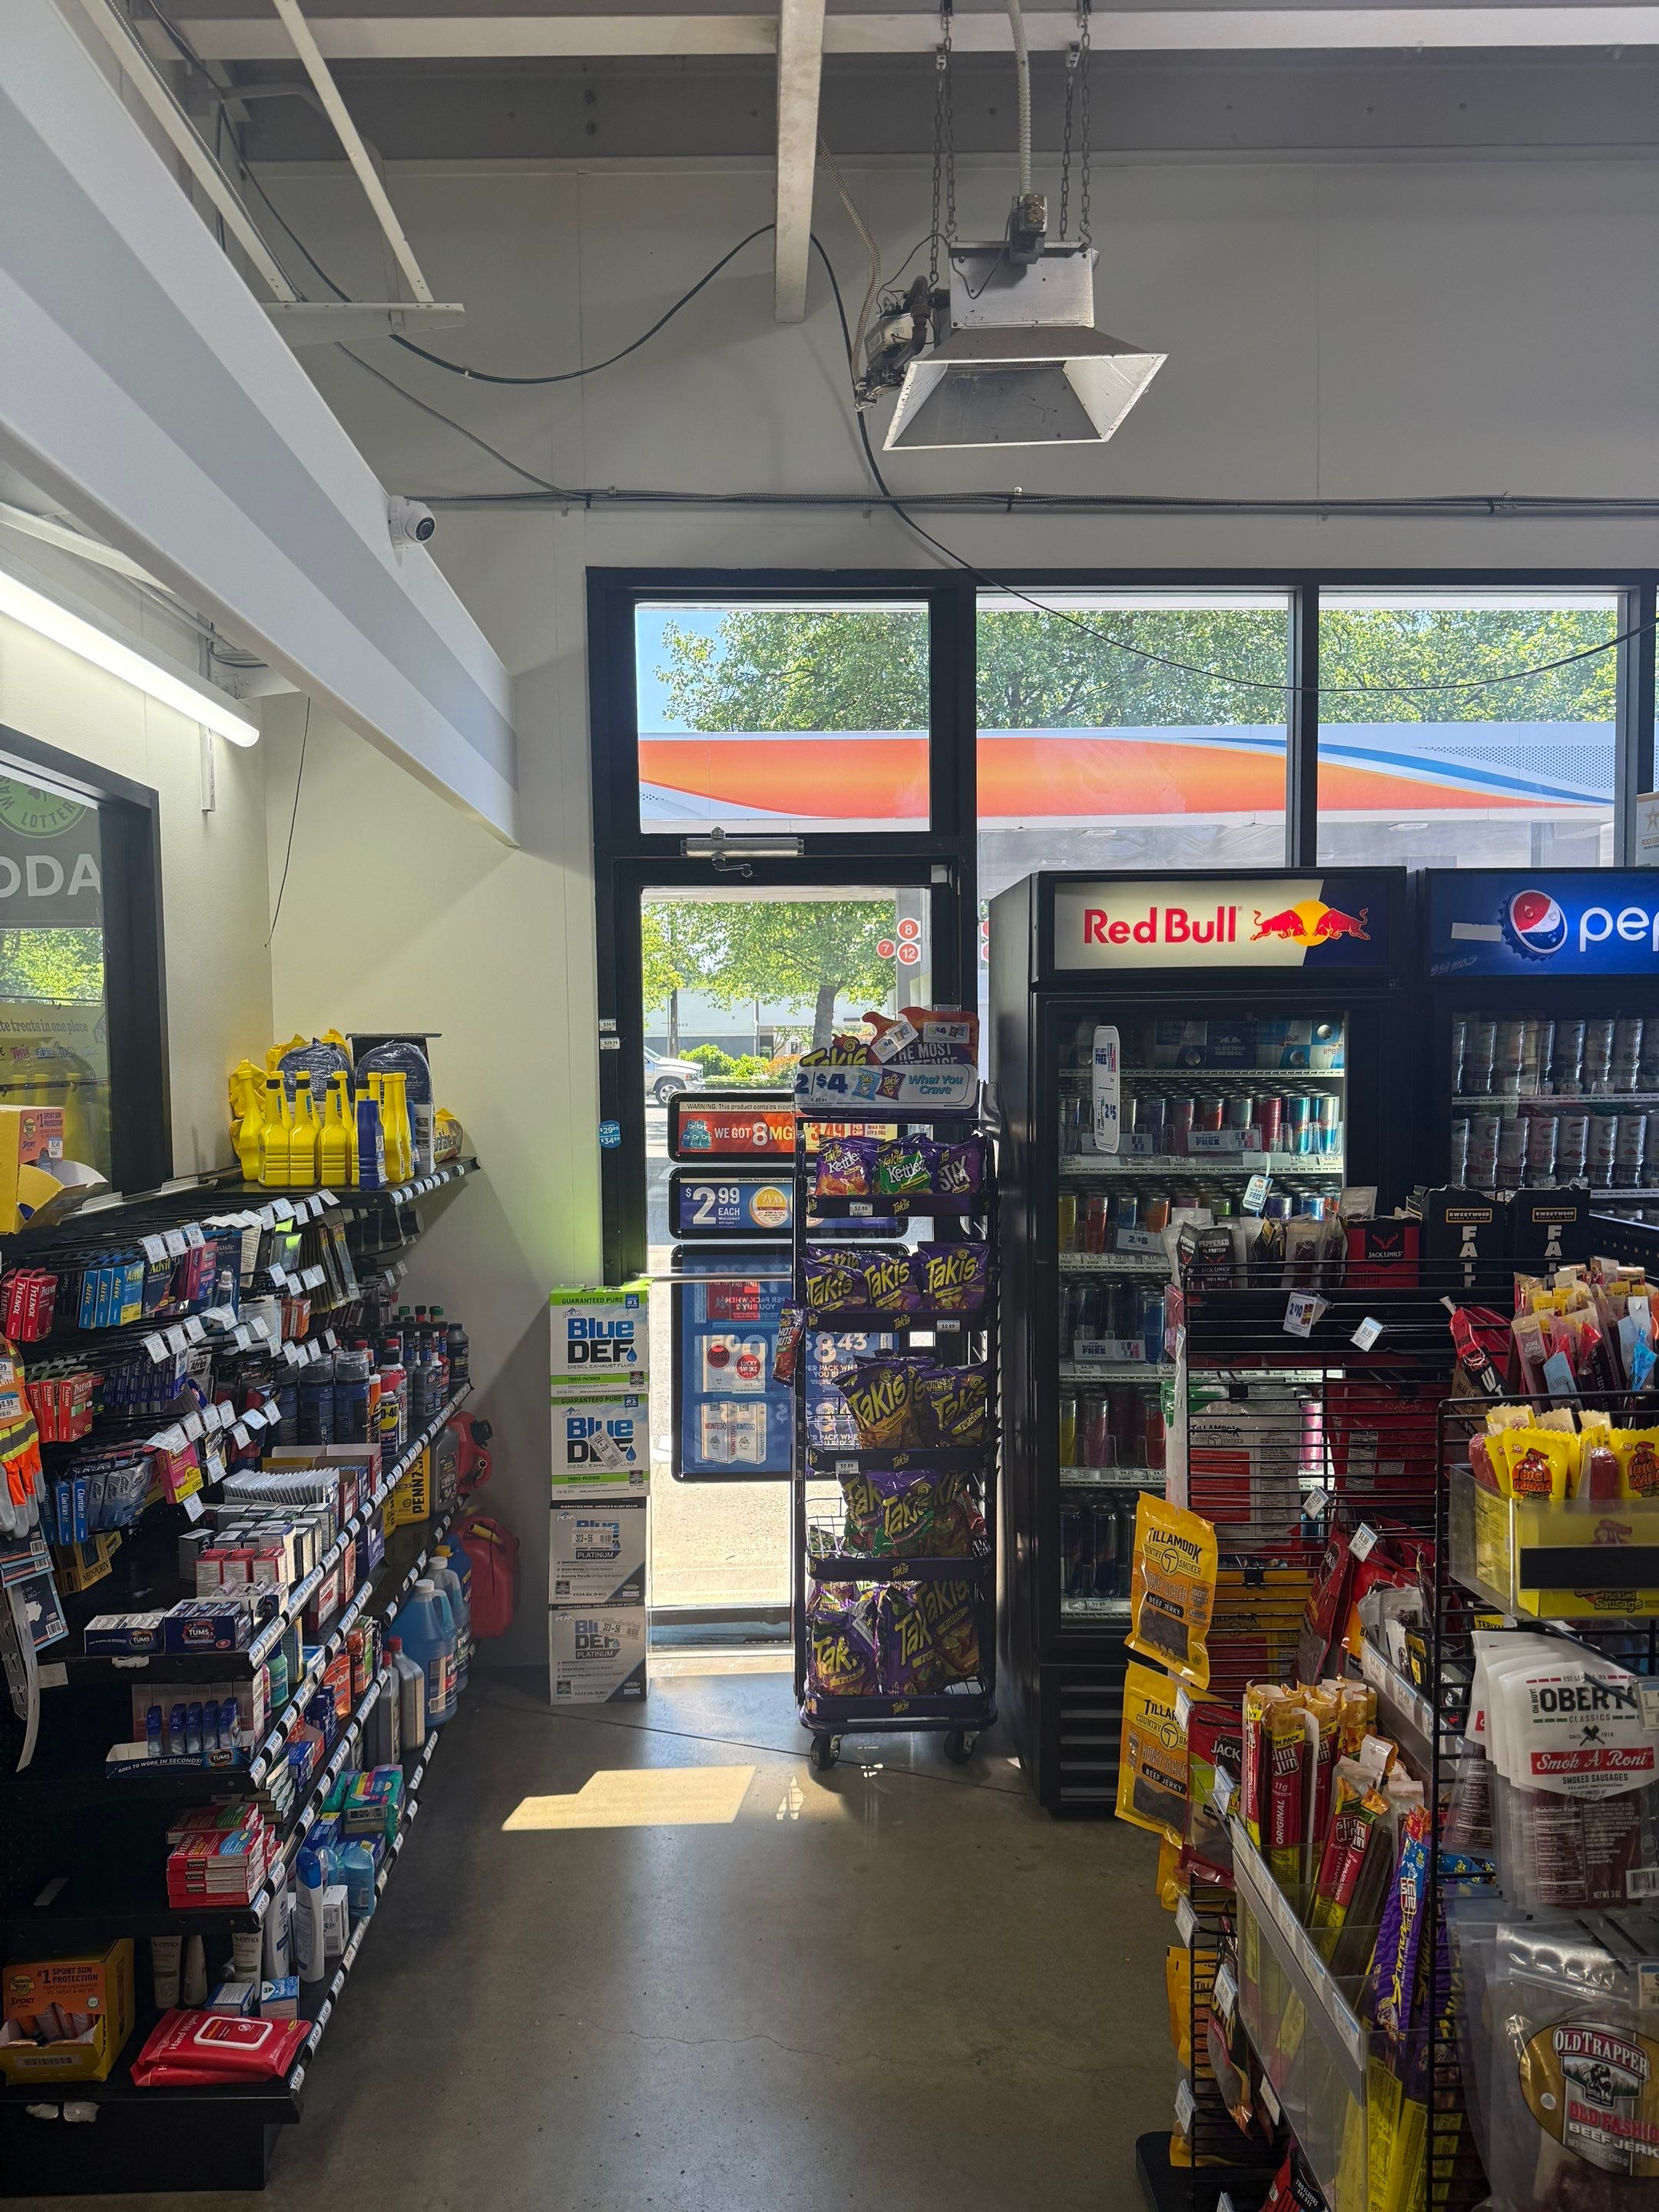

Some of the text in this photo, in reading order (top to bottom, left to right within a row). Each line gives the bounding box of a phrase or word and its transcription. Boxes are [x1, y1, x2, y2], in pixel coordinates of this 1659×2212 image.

[905, 925, 912, 935] 8
[1084, 906, 1237, 944] Red Bull
[882, 945, 889, 953] 7
[902, 948, 916, 959] 12
[51, 1022, 66, 1031] one
[67, 1019, 88, 1035] place
[919, 1043, 952, 1058] MOST
[908, 1075, 963, 1086] What You
[919, 1085, 952, 1095] Crave
[714, 1121, 768, 1146] WE GOT 8
[939, 1155, 971, 1190] STIX
[892, 1197, 910, 1215] Takis
[149, 1259, 171, 1274] Advil
[926, 1249, 977, 1293] Takis
[865, 1258, 910, 1303] Takis
[13, 1282, 25, 1315] TYLENOL
[28, 1285, 38, 1318] TYLENOL
[568, 1318, 634, 1339] Blue
[893, 1314, 911, 1330] Takis
[779, 1327, 793, 1337] HOT
[568, 1339, 635, 1363] DEF
[849, 1370, 906, 1430] Takis
[892, 1452, 909, 1469] Takis
[1634, 1462, 1653, 1475] BIG
[1520, 1470, 1542, 1481] BIG
[1514, 1480, 1552, 1493] MAMA
[1148, 1528, 1202, 1565] TILLAMOOK
[892, 1562, 909, 1578] Takis
[1179, 1560, 1201, 1575] SMOKER
[1164, 1580, 1187, 1603] GLAZED
[1149, 1596, 1181, 1616] BEEF JERKY
[1594, 1598, 1643, 1612] Sausage
[892, 1700, 909, 1714] Takis
[1136, 1714, 1161, 1733] COUNTRY
[1569, 1714, 1611, 1723] CLASSICS
[1283, 1734, 1300, 1744] PACK
[1142, 1743, 1164, 1767] HONEY
[1211, 1740, 1242, 1762] JACK
[118, 1765, 131, 1773] GOES
[141, 1760, 158, 1768] WORK
[169, 1757, 203, 1765] SECONDS!
[1537, 1750, 1648, 1770] Smok A Roni
[1146, 1768, 1182, 1791] BEEF JERKY
[1563, 1773, 1628, 1784] SMOKED SAUSAGES
[1275, 1782, 1288, 1792] 11g
[1276, 1800, 1285, 1844] ORIGINAL
[37, 1970, 51, 1984] #1
[52, 1975, 98, 1983] PROTECTION
[11, 1997, 35, 2005] SPORT
[169, 2014, 200, 2050] Hand Wipes
[1555, 2030, 1649, 2078] OLD TRAPPER
[1569, 2101, 1599, 2127] OLD
[1569, 2123, 1611, 2144] BEEF
